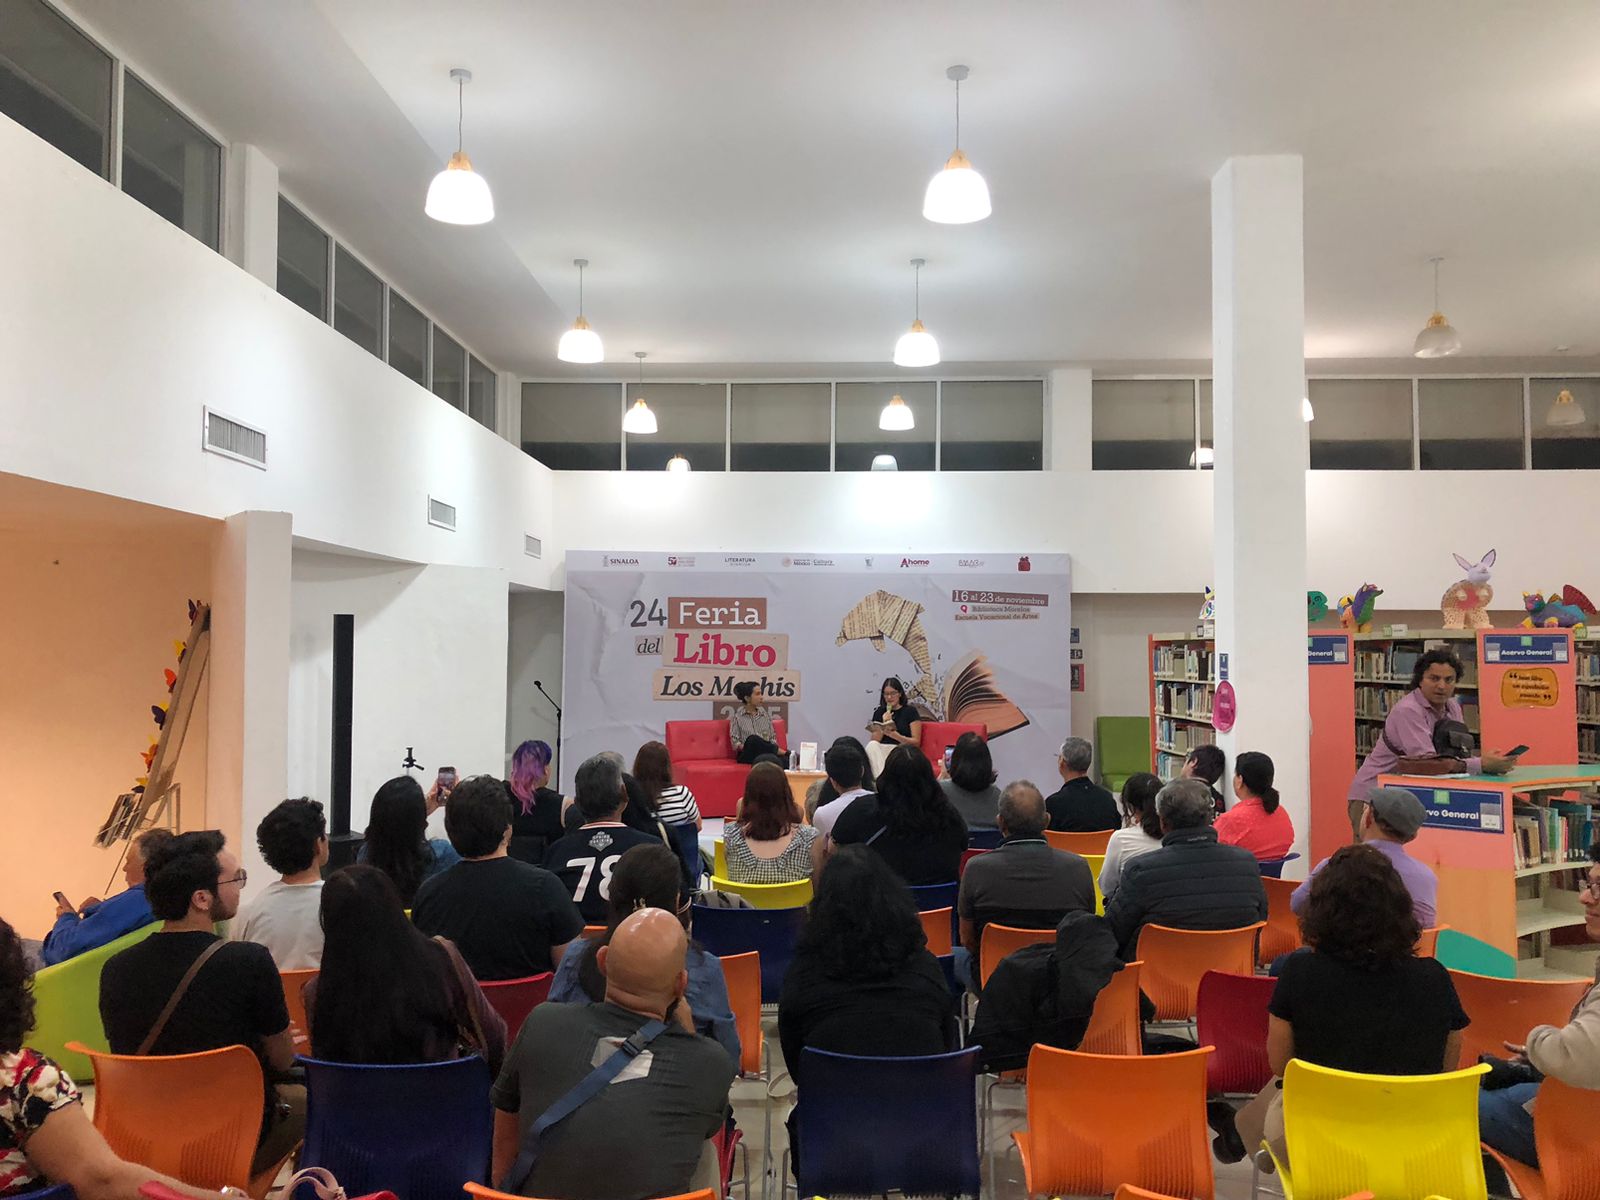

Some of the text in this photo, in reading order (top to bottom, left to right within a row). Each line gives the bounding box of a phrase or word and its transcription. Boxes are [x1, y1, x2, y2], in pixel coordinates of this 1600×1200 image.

[900, 558, 930, 567] Ahome
[954, 590, 969, 602] 16
[970, 593, 978, 601] al
[980, 592, 994, 603] 23
[1006, 597, 1045, 605] noviembre
[630, 598, 761, 628] 24 Feria
[637, 633, 777, 668] del Libro
[661, 675, 795, 697] Los Mhis
[1441, 809, 1479, 820] General
